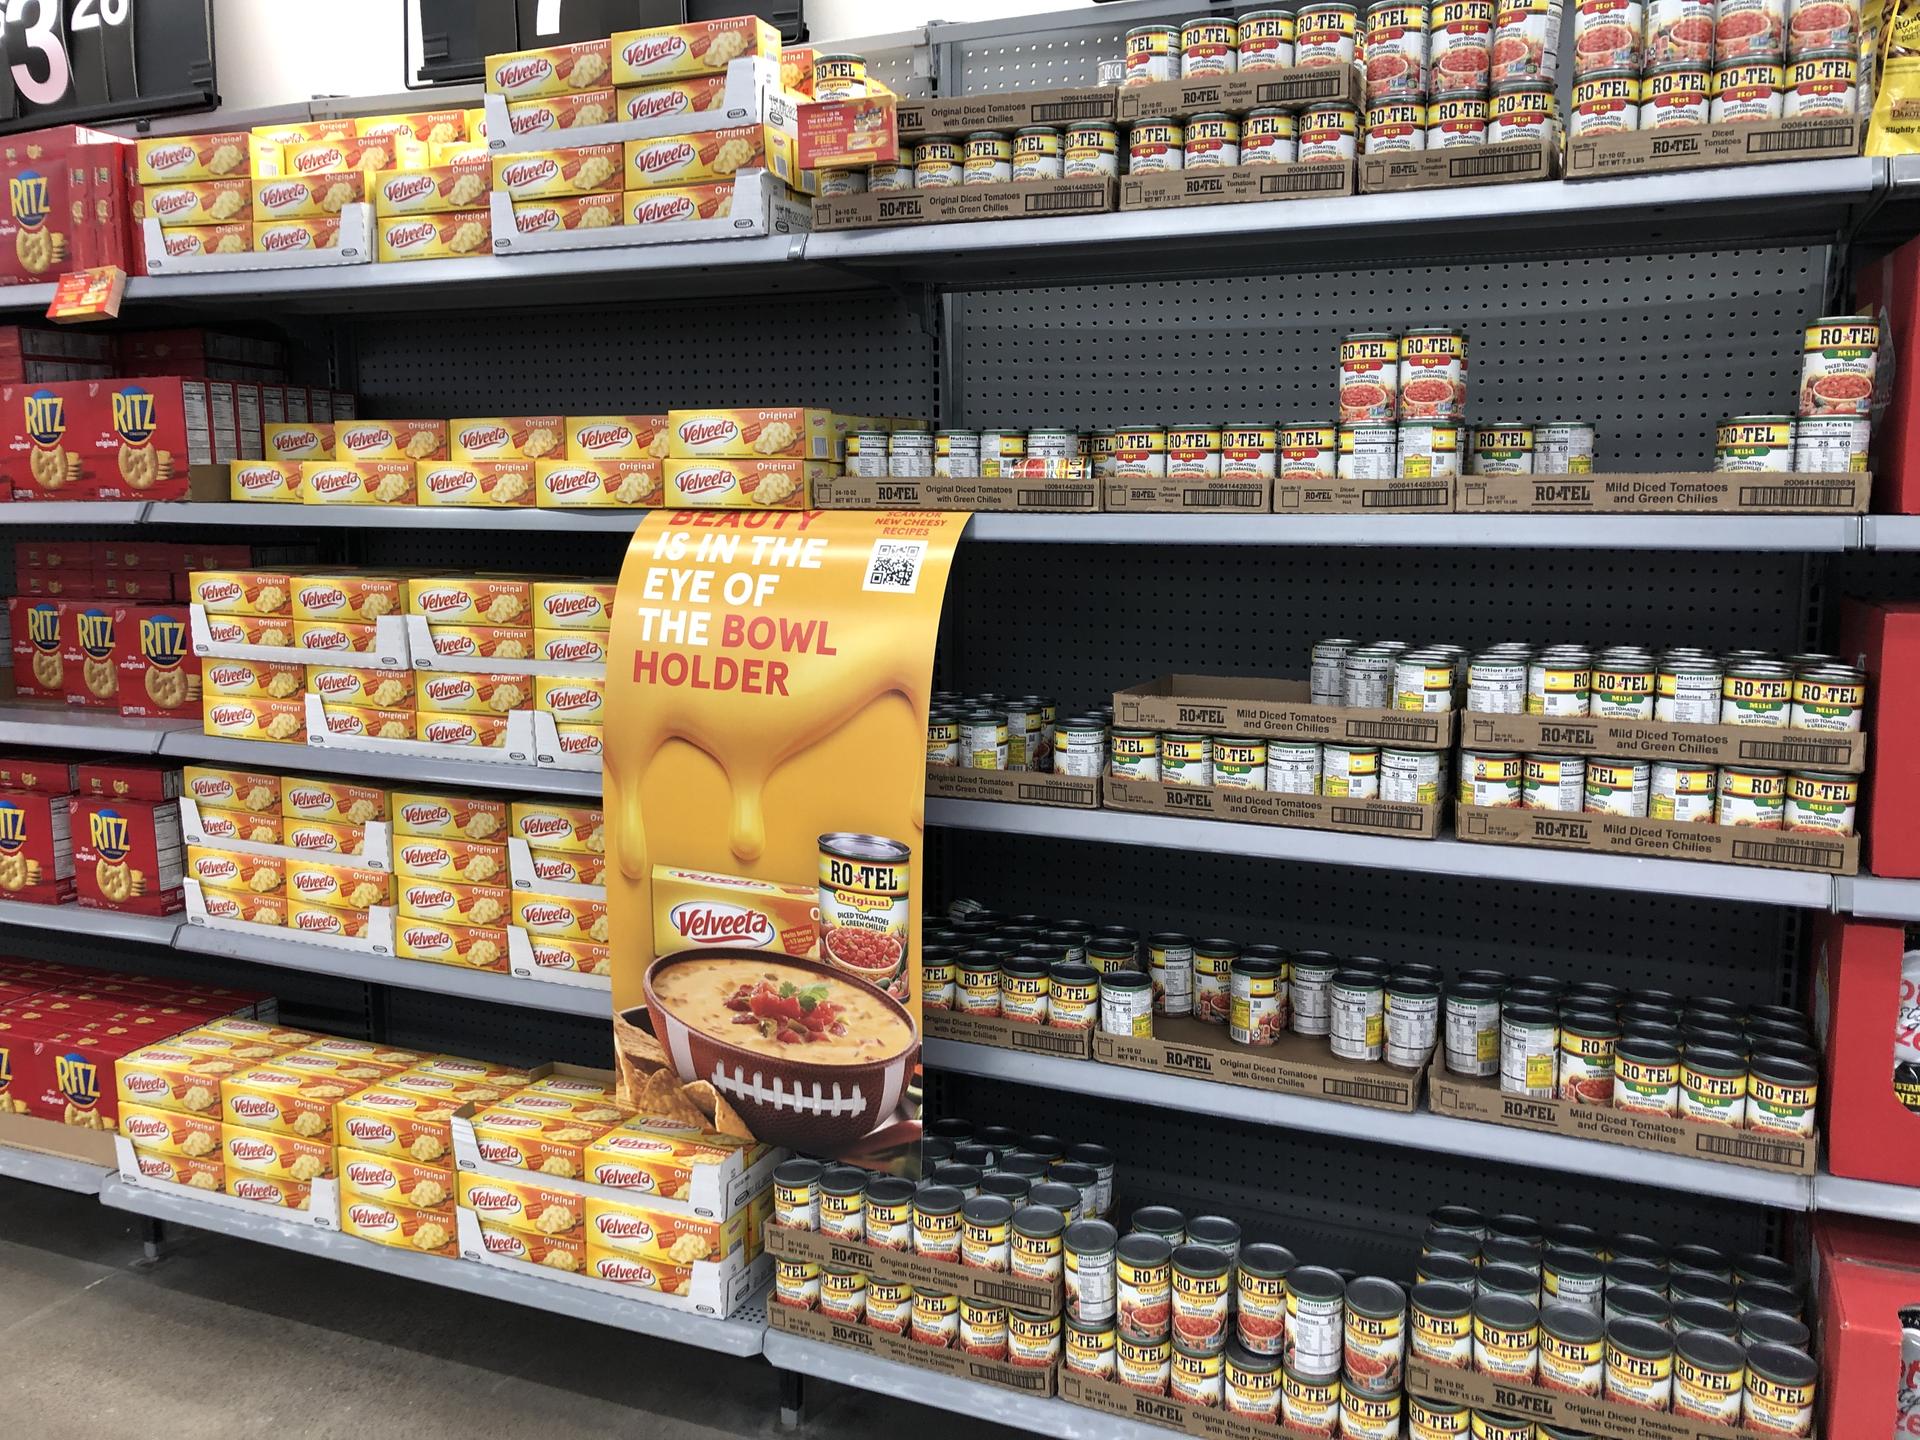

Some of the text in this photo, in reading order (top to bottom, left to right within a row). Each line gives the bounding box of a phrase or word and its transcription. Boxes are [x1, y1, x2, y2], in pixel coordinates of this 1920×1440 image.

[708, 19, 748, 32] Original
[623, 35, 684, 62] Velveeta
[1200, 47, 1215, 56] Hot
[1592, 103, 1612, 111] Hot
[211, 134, 242, 145] Original
[715, 127, 755, 139] Original
[815, 134, 837, 145] FREE
[1712, 129, 1734, 137] Diced
[1705, 138, 1742, 147] Tomatoes
[636, 144, 692, 167] Velveeta
[1715, 146, 1729, 154] Hot
[146, 148, 193, 169] Velveeta
[453, 165, 484, 174] Original
[503, 160, 556, 183] Velveeta
[385, 180, 434, 200] Velveeta
[10, 178, 50, 217] RITZ
[930, 193, 1020, 206] Original Diced Tomatoes
[941, 206, 956, 214] with
[958, 205, 981, 214] Green
[1422, 357, 1438, 365] Hot
[113, 392, 156, 430] RITZ
[758, 412, 796, 420] Original
[409, 422, 439, 430] Original
[681, 421, 735, 445] Velveeta
[344, 430, 391, 450] Velveeta
[926, 486, 1012, 494] Original Diced Tomatoes
[1605, 482, 1728, 493] Mild Diced Tomatoes
[1614, 494, 1634, 503] and
[1637, 494, 1674, 504] Green
[668, 511, 824, 531] BEAUTY
[902, 518, 948, 526] CHEESY
[883, 528, 930, 536] RECIPES
[652, 531, 829, 569] IS IN THE
[257, 577, 285, 585] Original
[362, 584, 392, 592] Original
[644, 567, 780, 607] EYE OF
[489, 585, 522, 593] Original
[300, 591, 345, 608] Velveeta
[544, 595, 599, 614] Velveeta
[140, 620, 186, 657] RITZ
[638, 607, 837, 656] THE BOWL
[213, 669, 252, 684] Velveeta
[633, 650, 789, 697] HOLDER
[547, 690, 600, 709] Velveeta
[1237, 710, 1337, 724] Mild Diced Tomatoes
[1243, 721, 1260, 730] and
[1262, 722, 1295, 732] Green
[1609, 728, 1728, 743] Mild Diced Tomatoes
[1617, 740, 1638, 750] and
[1640, 741, 1673, 752] Green
[1223, 765, 1241, 773] Mild
[405, 807, 448, 823] Velveeta
[90, 809, 130, 850] RITZ
[198, 860, 235, 875] Velveeta
[354, 872, 381, 882] Original
[408, 890, 452, 907] Velveeta
[838, 893, 890, 907] Original
[679, 910, 768, 936] Velveeta
[855, 913, 889, 925] TOMATOES
[865, 922, 887, 932] CHILIES
[1220, 1058, 1318, 1080] Original Diced Tomatoes
[56, 1056, 100, 1100] RITZ
[127, 1076, 166, 1094] Velveeta
[183, 1076, 213, 1086] Original
[1635, 1086, 1657, 1094] Mild
[1570, 1108, 1685, 1136] Mild Diced Tomatoes
[350, 1122, 392, 1139] Velveeta
[411, 1124, 444, 1136] Original
[1577, 1121, 1598, 1131] and
[1600, 1124, 1633, 1138] Green
[541, 1145, 576, 1157] Original
[600, 1171, 650, 1190] Velveeta
[352, 1209, 395, 1227] Velveeta
[599, 1218, 650, 1237] Velveeta
[674, 1221, 712, 1235] Original
